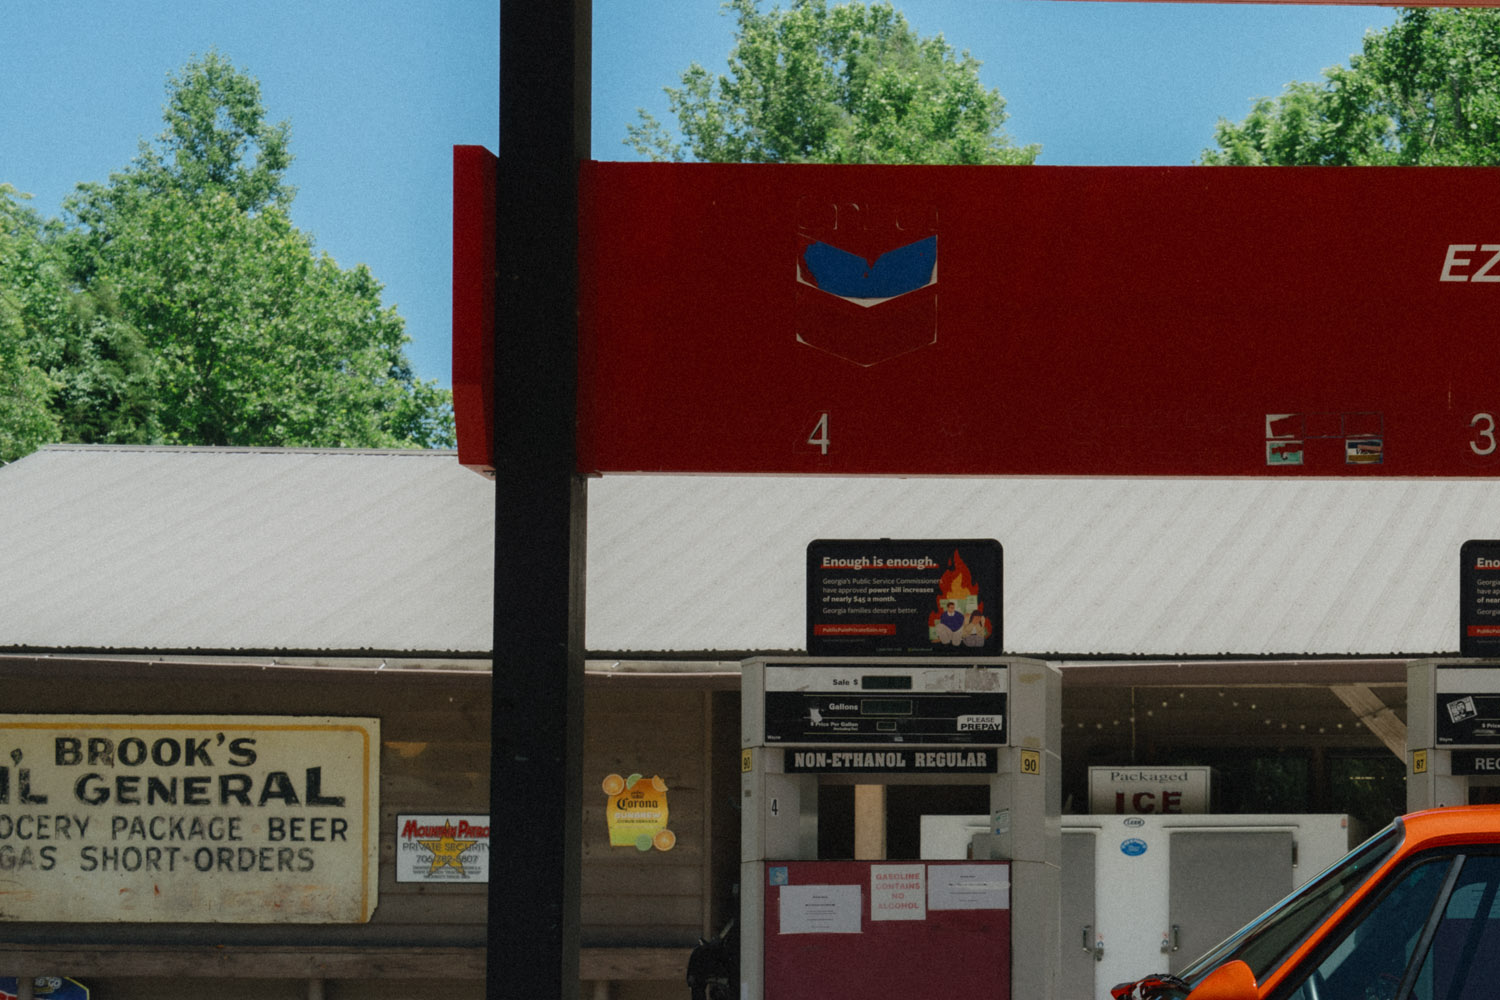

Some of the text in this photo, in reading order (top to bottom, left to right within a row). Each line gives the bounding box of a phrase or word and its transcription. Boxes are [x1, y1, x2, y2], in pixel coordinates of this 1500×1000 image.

[807, 413, 830, 455] 4
[1469, 412, 1497, 455] 3
[822, 556, 937, 570] Enough is enough.
[822, 578, 850, 587] Georgia's
[838, 587, 868, 595] approved
[891, 586, 901, 594] bill
[903, 586, 934, 594] increases
[831, 596, 852, 604] nearly
[1477, 596, 1484, 604] of
[822, 607, 846, 615] Georgia
[1477, 608, 1500, 616] Georgia
[832, 678, 859, 687] Sale $
[829, 703, 858, 711] Gallons
[960, 723, 1001, 731] PREPAY
[54, 732, 258, 767] BROOK'S
[743, 755, 750, 771] 90
[794, 752, 987, 768] NON-ETHANOL REGULAR
[1024, 758, 1037, 772] 90
[1416, 758, 1424, 770] 87
[1111, 771, 1188, 783] Packaged
[74, 766, 346, 808] GENERAL
[616, 797, 658, 811] Corona
[771, 799, 778, 815] 4
[1115, 791, 1182, 814] ICE
[111, 815, 243, 842] PACKAGE
[268, 817, 348, 842] BEER
[402, 842, 441, 852] PRIVATE
[0, 845, 57, 872] GAS
[875, 882, 921, 890] CONTAINS
[878, 902, 920, 910] ALCOHOL
